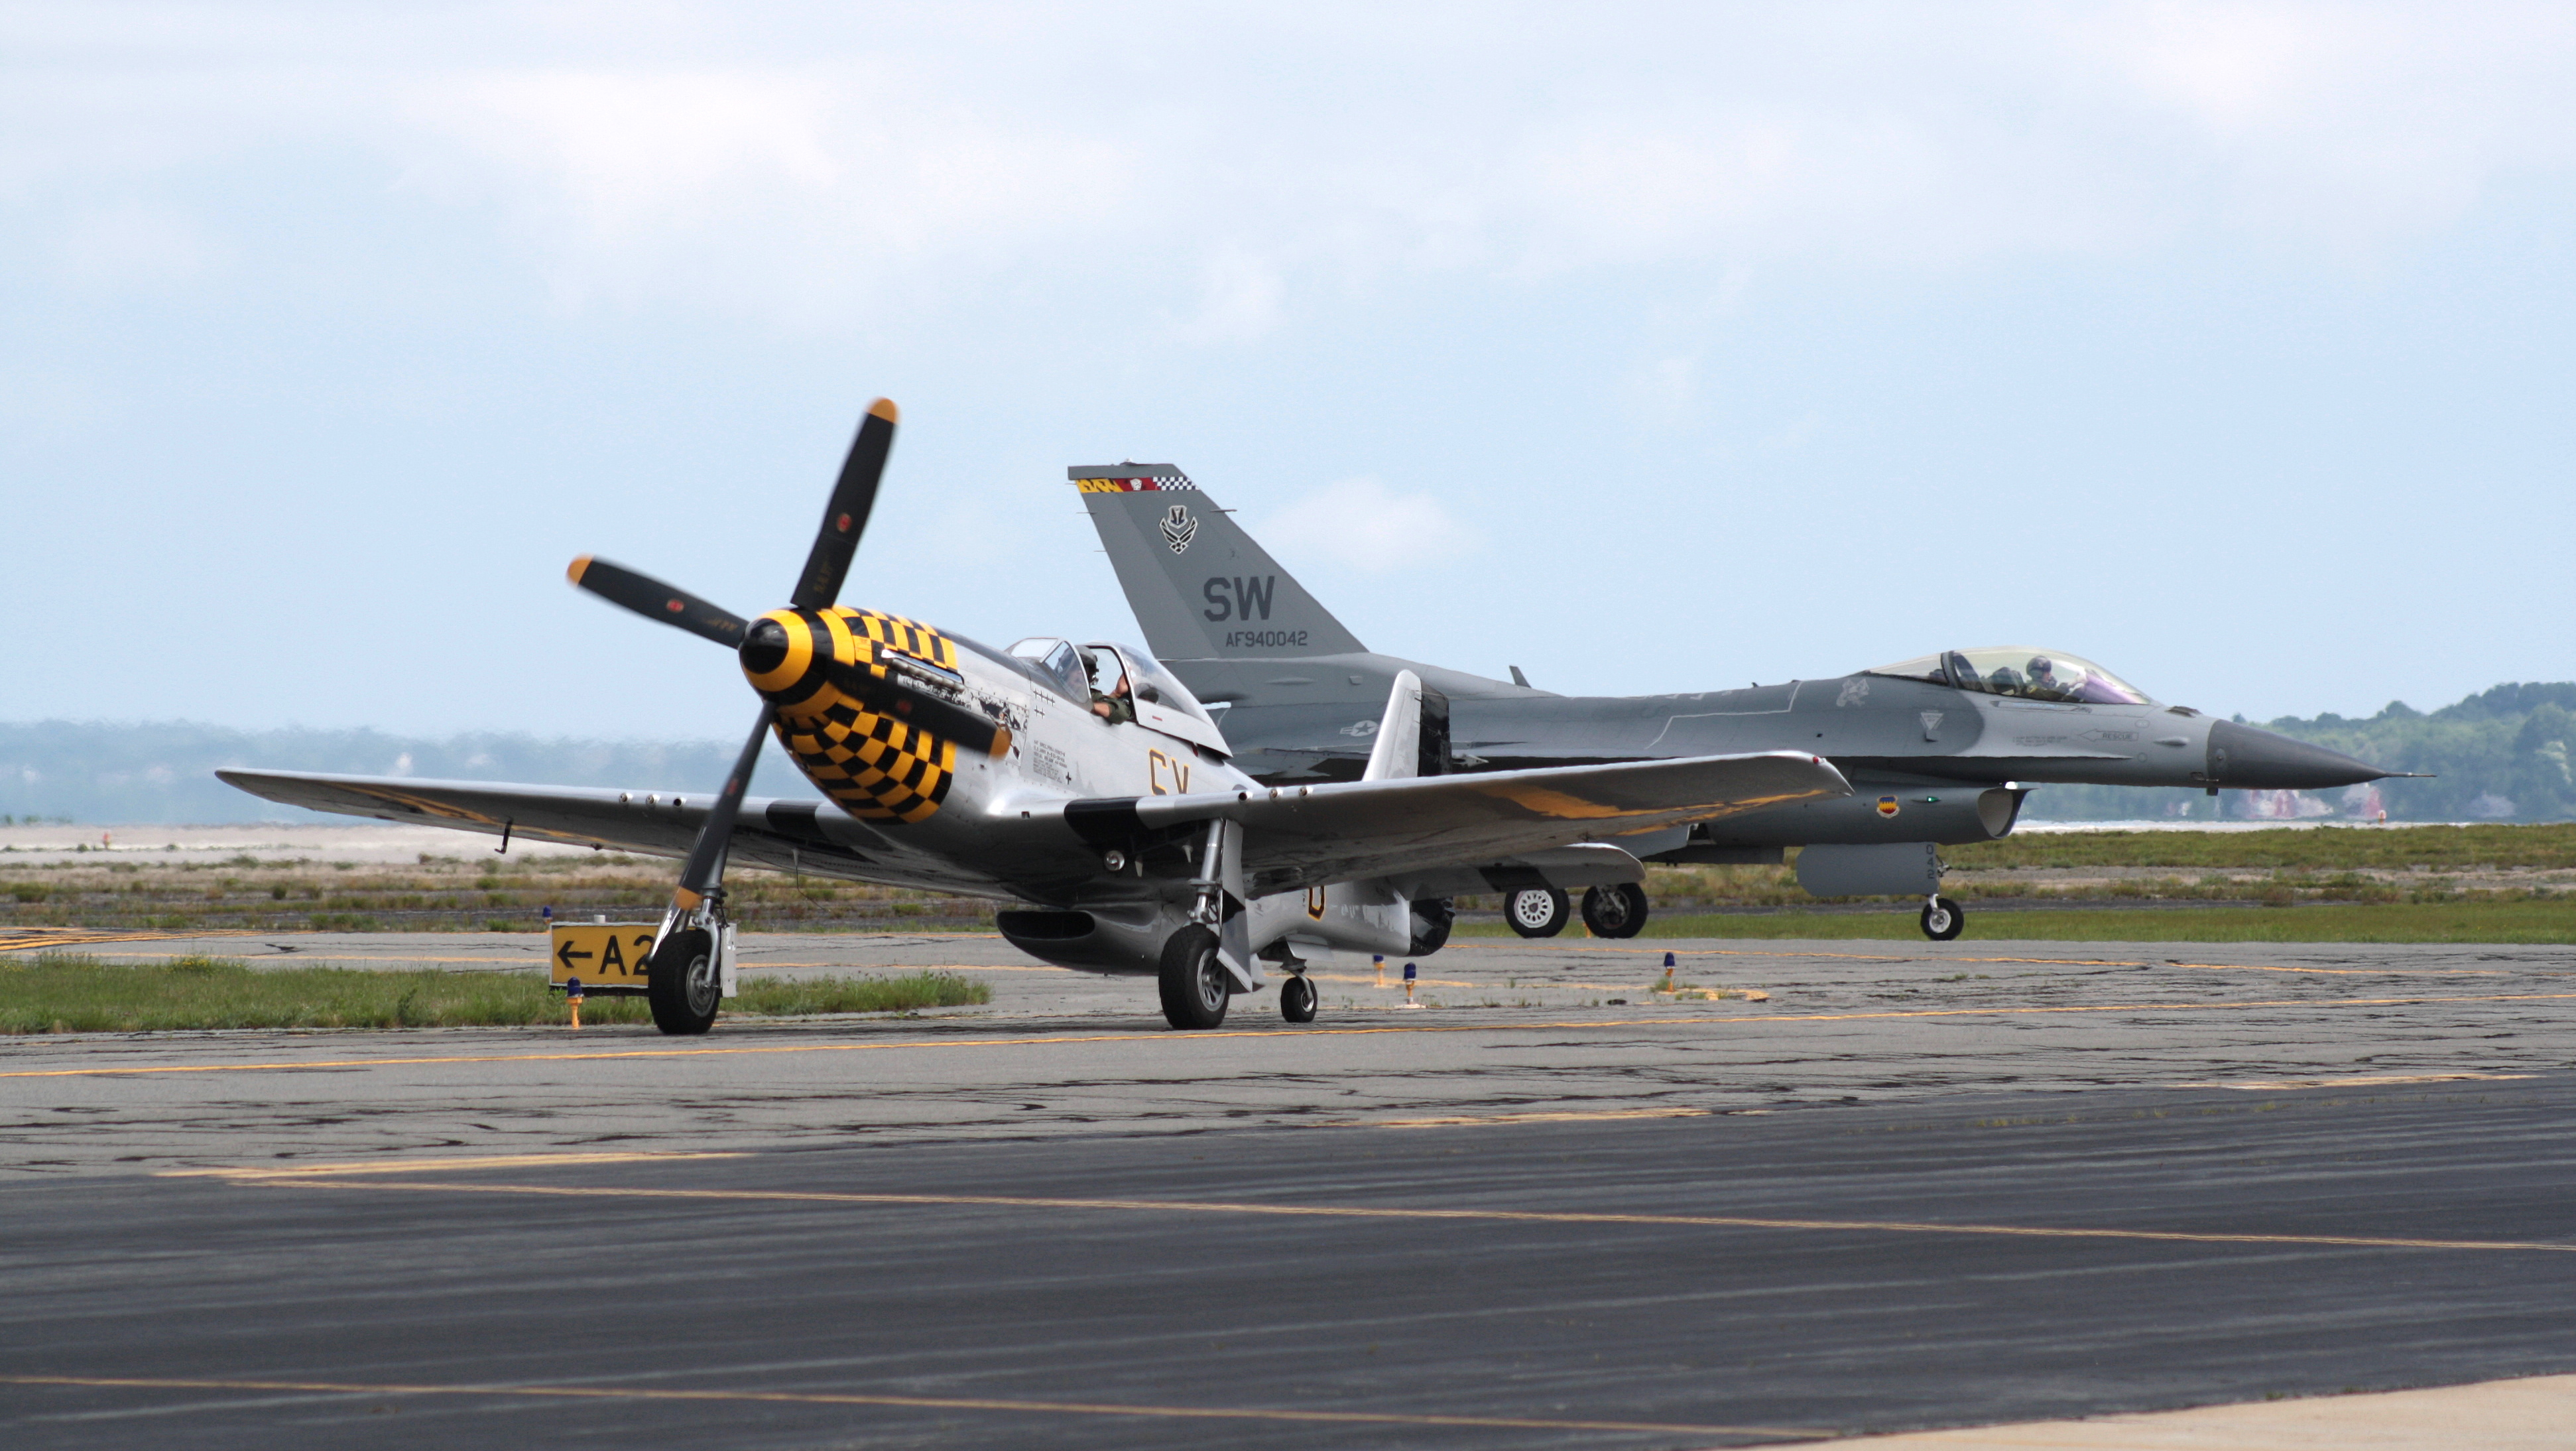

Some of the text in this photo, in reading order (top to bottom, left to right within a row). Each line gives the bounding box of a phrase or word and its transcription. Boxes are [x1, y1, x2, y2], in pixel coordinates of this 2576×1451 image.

[1203, 576, 1275, 622] SW
[1225, 631, 1308, 648] AF940042
[599, 934, 655, 976] A2
